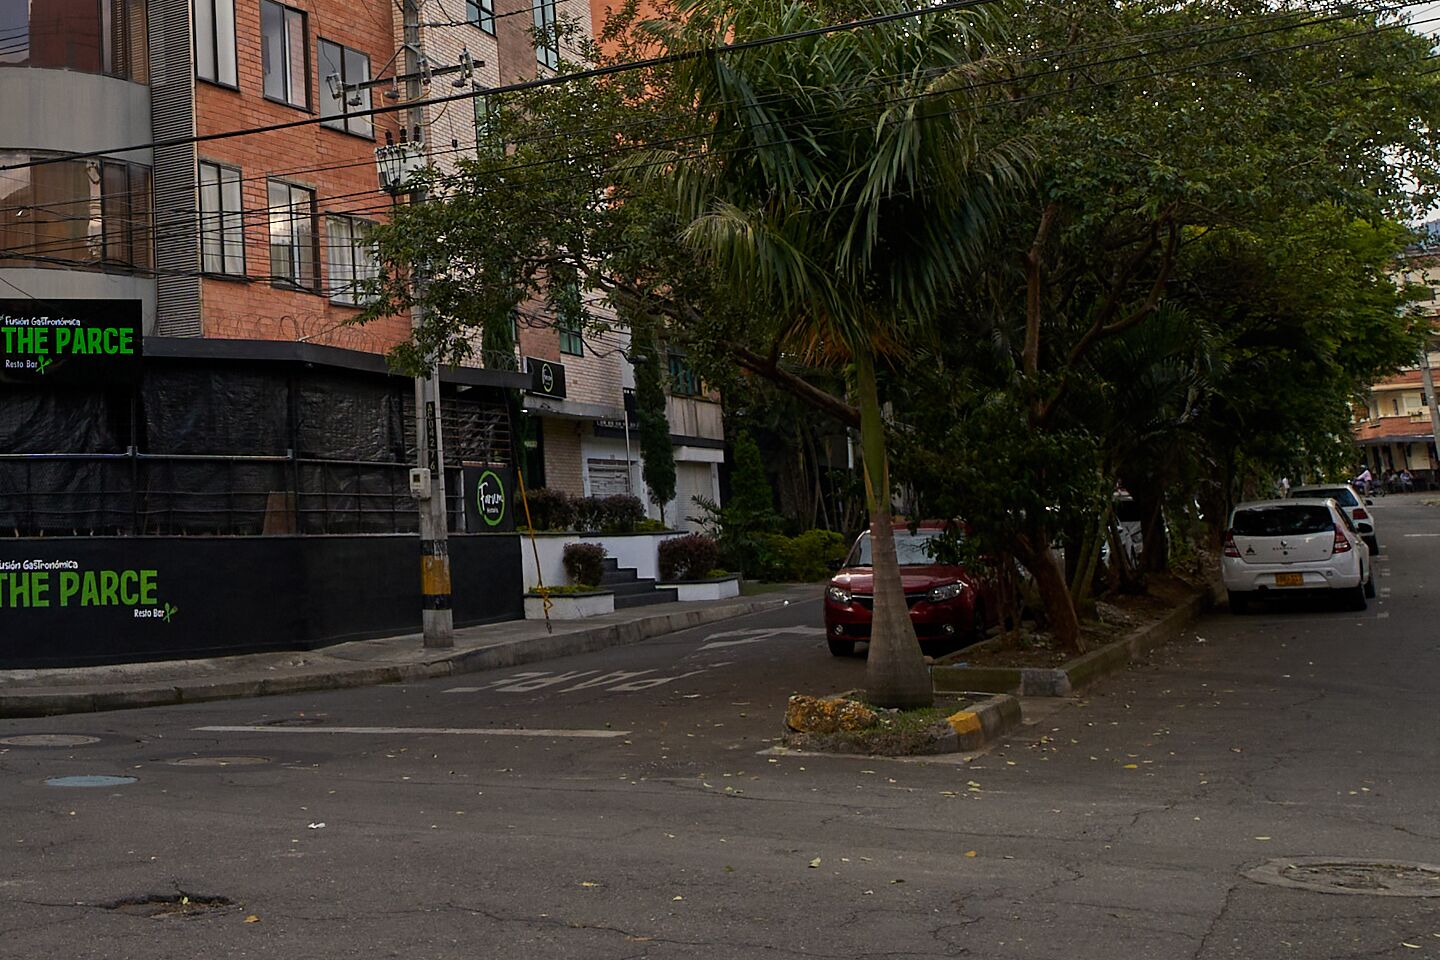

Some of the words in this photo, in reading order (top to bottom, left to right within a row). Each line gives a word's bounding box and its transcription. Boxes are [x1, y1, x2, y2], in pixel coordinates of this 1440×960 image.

[5, 315, 30, 326] Fusión
[1, 327, 49, 354] THE
[56, 327, 134, 354] PARCE
[5, 359, 24, 368] Resto
[26, 359, 38, 368] Bar
[60, 570, 158, 607] PARCE
[134, 609, 152, 618] Resto
[153, 609, 165, 618] Bar
